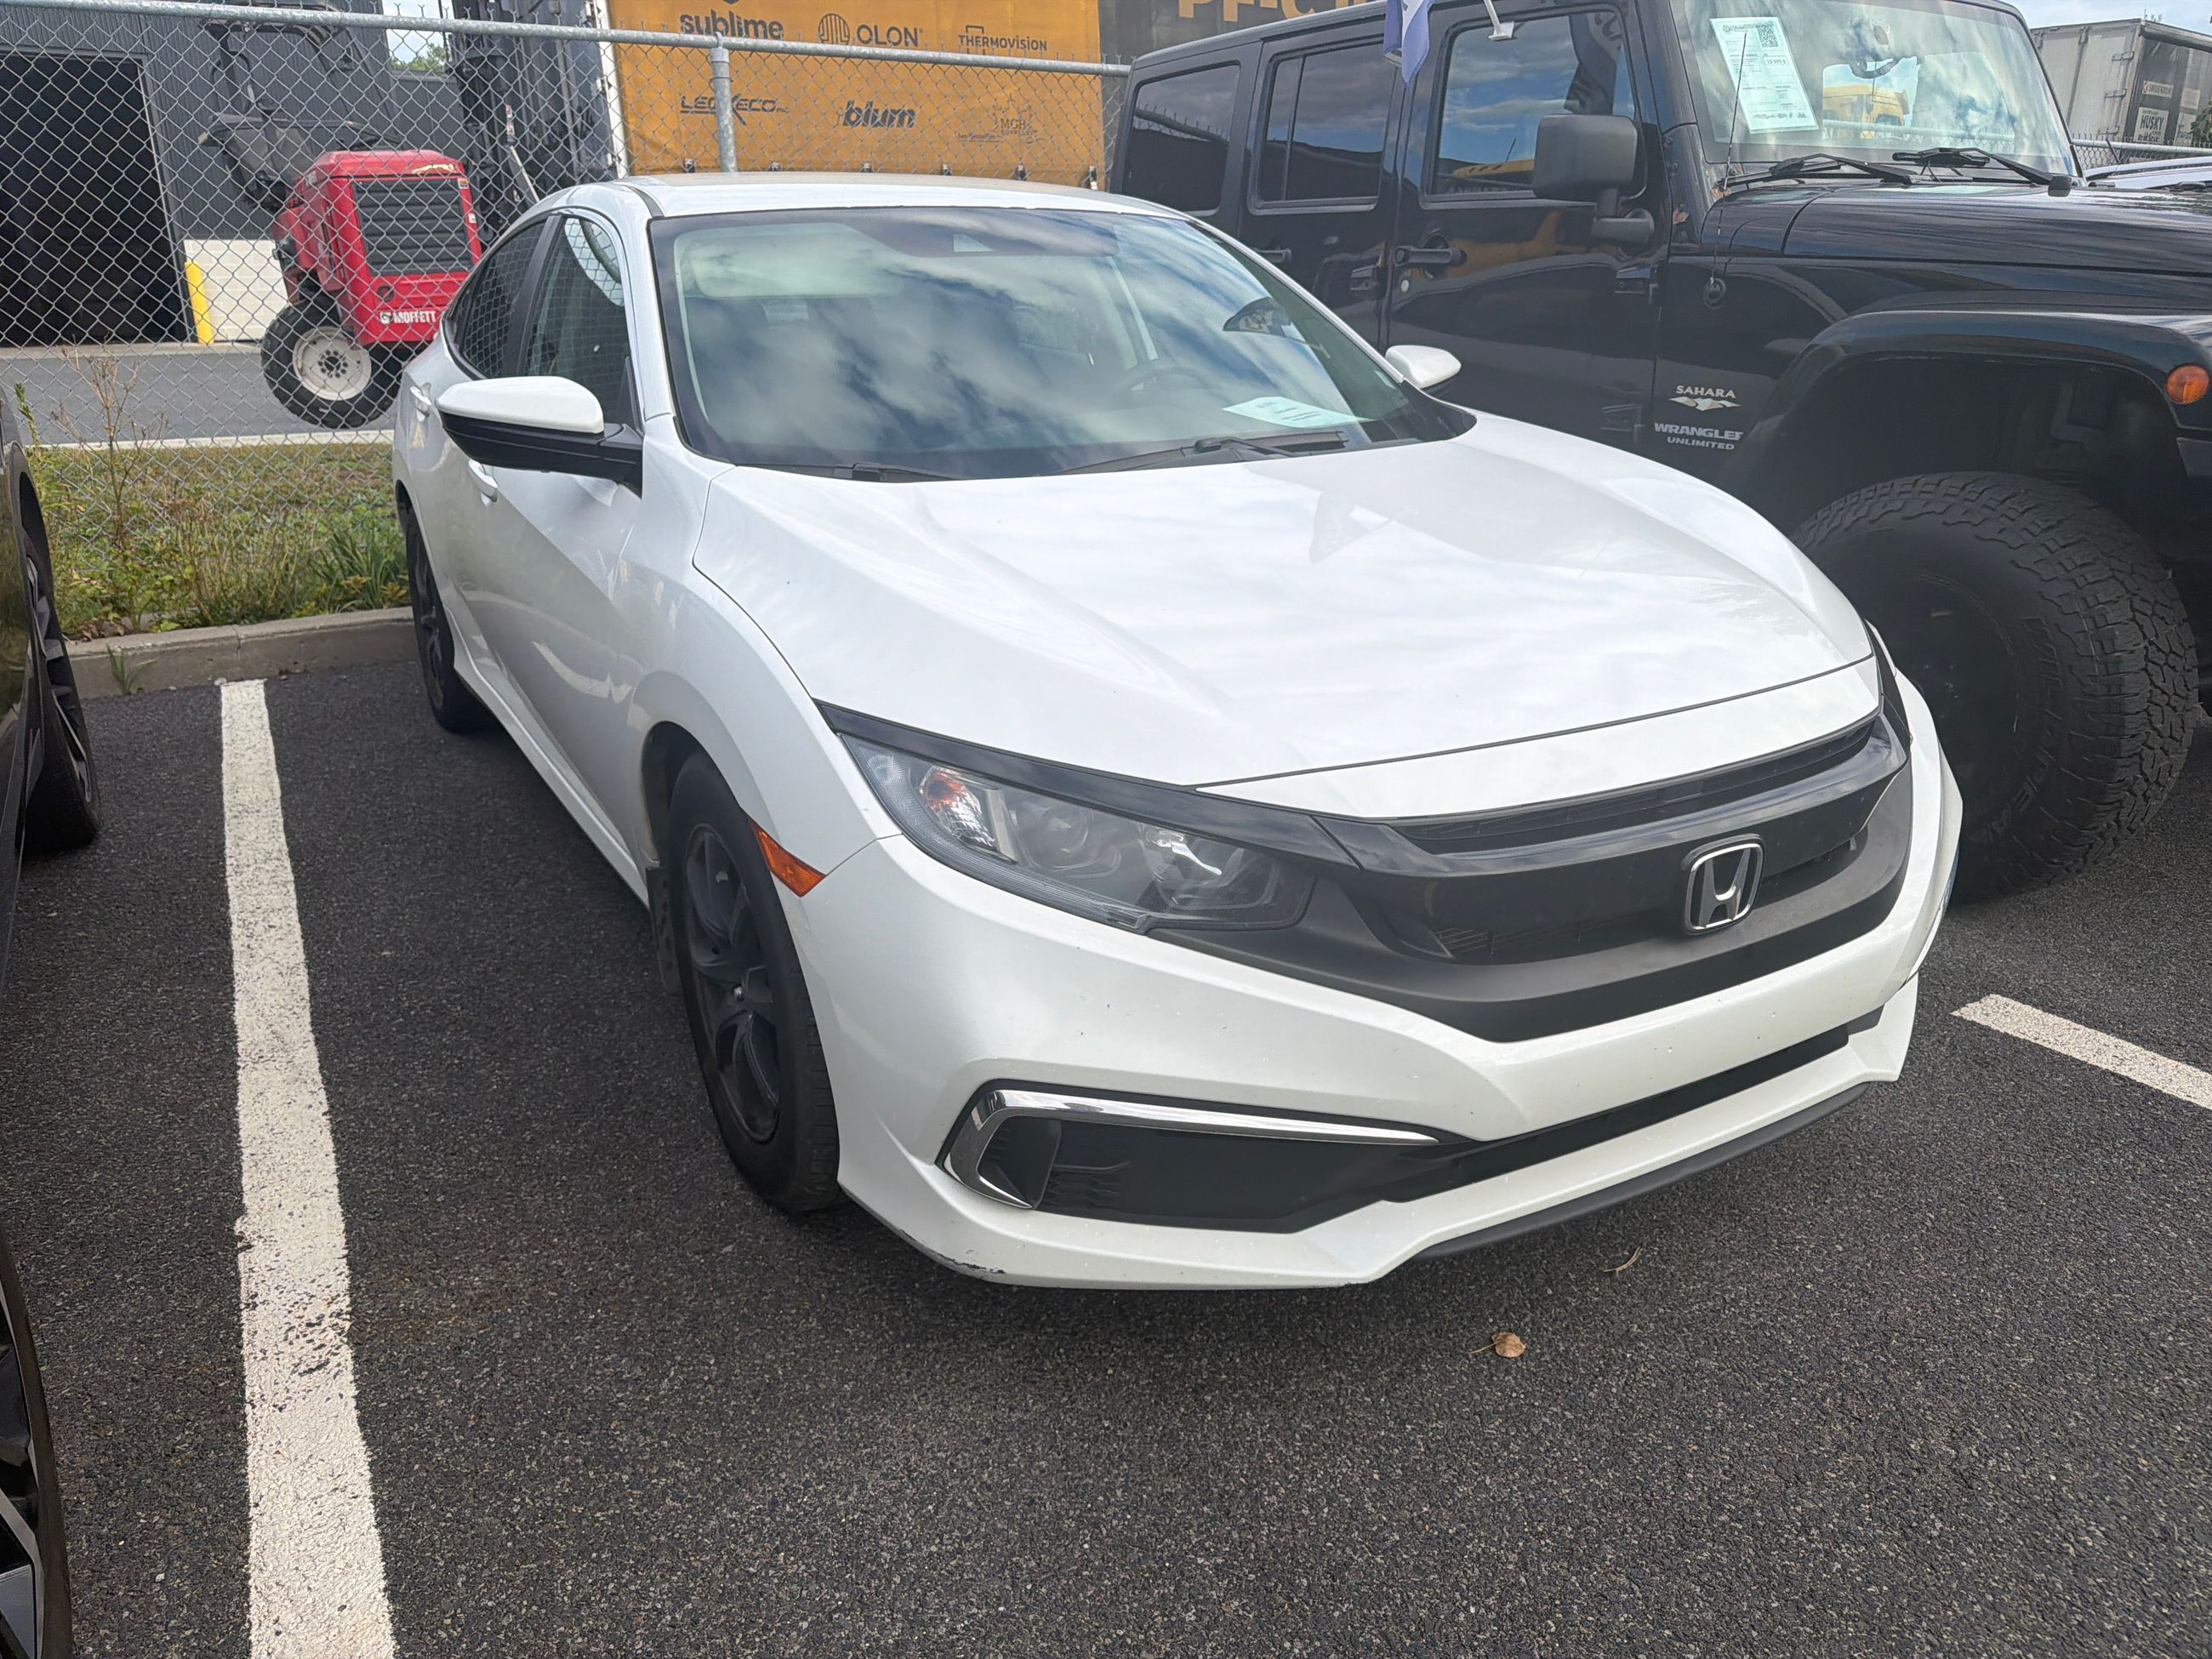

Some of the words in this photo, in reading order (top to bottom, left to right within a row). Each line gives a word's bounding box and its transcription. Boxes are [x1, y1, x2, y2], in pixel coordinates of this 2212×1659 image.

[680, 9, 784, 40] sublime
[857, 24, 919, 48] OLON
[958, 35, 1047, 51] THERMOVISION
[842, 100, 915, 128] blum
[2140, 115, 2164, 130] HUSKY
[394, 311, 436, 324] MOFFETT
[1675, 385, 1736, 398] SAHARA
[1667, 436, 1735, 450] UNLIMITED
